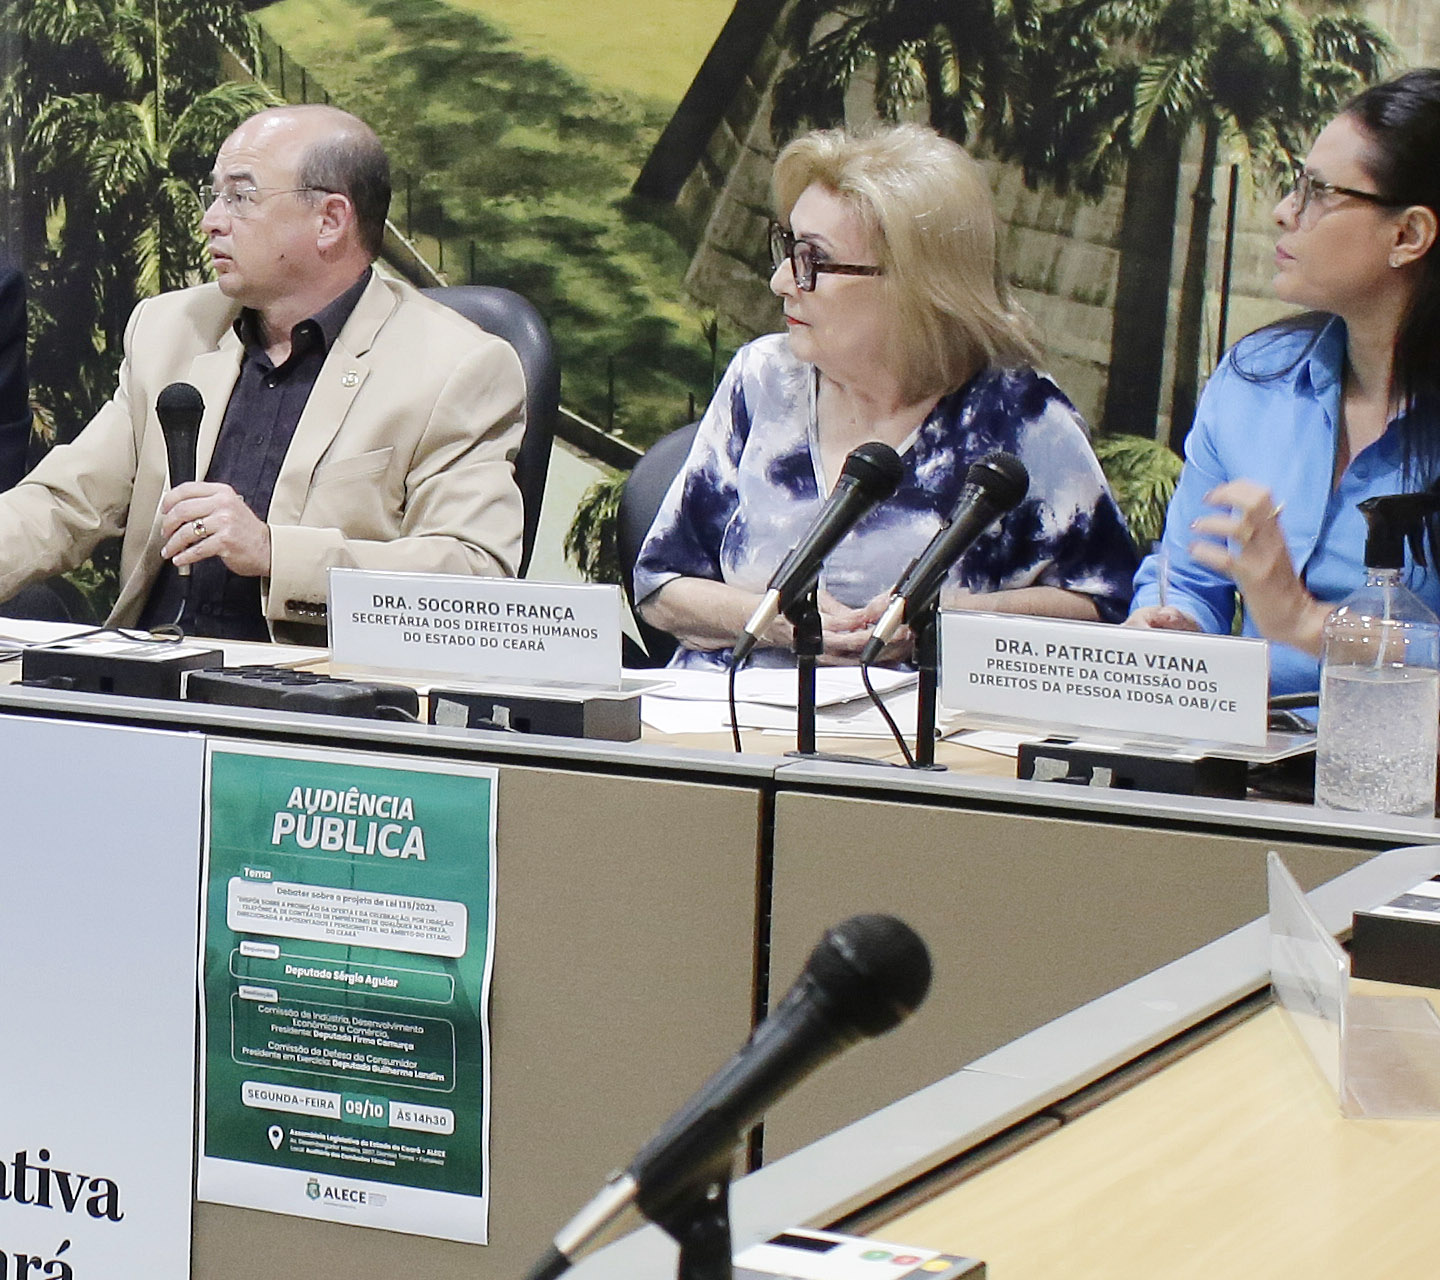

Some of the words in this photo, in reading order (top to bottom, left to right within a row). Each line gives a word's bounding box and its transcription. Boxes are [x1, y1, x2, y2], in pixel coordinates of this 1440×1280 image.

[373, 595, 412, 609] DRA.
[418, 597, 499, 616] SOCORRO
[506, 604, 574, 623] FRANÇA
[352, 611, 429, 627] SECRETÁRIA
[434, 618, 460, 629] DOS
[465, 620, 527, 634] DIREITOS
[533, 625, 598, 639] HUMANOS
[404, 632, 420, 643] DO
[426, 634, 475, 646] ESTADO
[480, 637, 498, 648] DO
[503, 637, 544, 651] CEARÁ
[995, 639, 1038, 656] DRA.
[1046, 644, 1137, 667] PATRICIA
[1145, 654, 1208, 674] VIANA
[987, 658, 1074, 678] PRESIDENTE
[1079, 668, 1098, 680] DA
[1104, 670, 1181, 689] COMISSÃO
[1187, 680, 1217, 692] DOS
[970, 673, 1037, 690] DIREITOS
[1042, 681, 1061, 693] DA
[1066, 683, 1120, 699] PESSOA
[1126, 689, 1173, 705] IDOSA
[1178, 695, 1236, 712] OAB/CE
[287, 786, 414, 820] AUDIÊNCIA
[272, 808, 425, 860] PÚBLICA
[244, 867, 271, 879] Tema
[277, 886, 309, 897] Debater
[311, 890, 334, 900] sobre
[343, 895, 371, 906] projeto
[373, 898, 383, 906] de
[386, 899, 396, 907] Lei
[285, 964, 331, 981] Deputado
[333, 969, 363, 985] Sérgio
[365, 974, 398, 989] Aguiar
[268, 1041, 308, 1053] Comissão
[311, 1047, 321, 1055] de
[323, 1048, 351, 1059] Defesa
[353, 1053, 364, 1061] do
[366, 1054, 417, 1068] Consumidor
[248, 1089, 335, 1110] SEGUNDA-FEIRA
[346, 1099, 383, 1119] 09/10
[397, 1109, 411, 1121] ÀS
[414, 1113, 446, 1126] 14h30
[324, 1187, 366, 1203] ALECE
